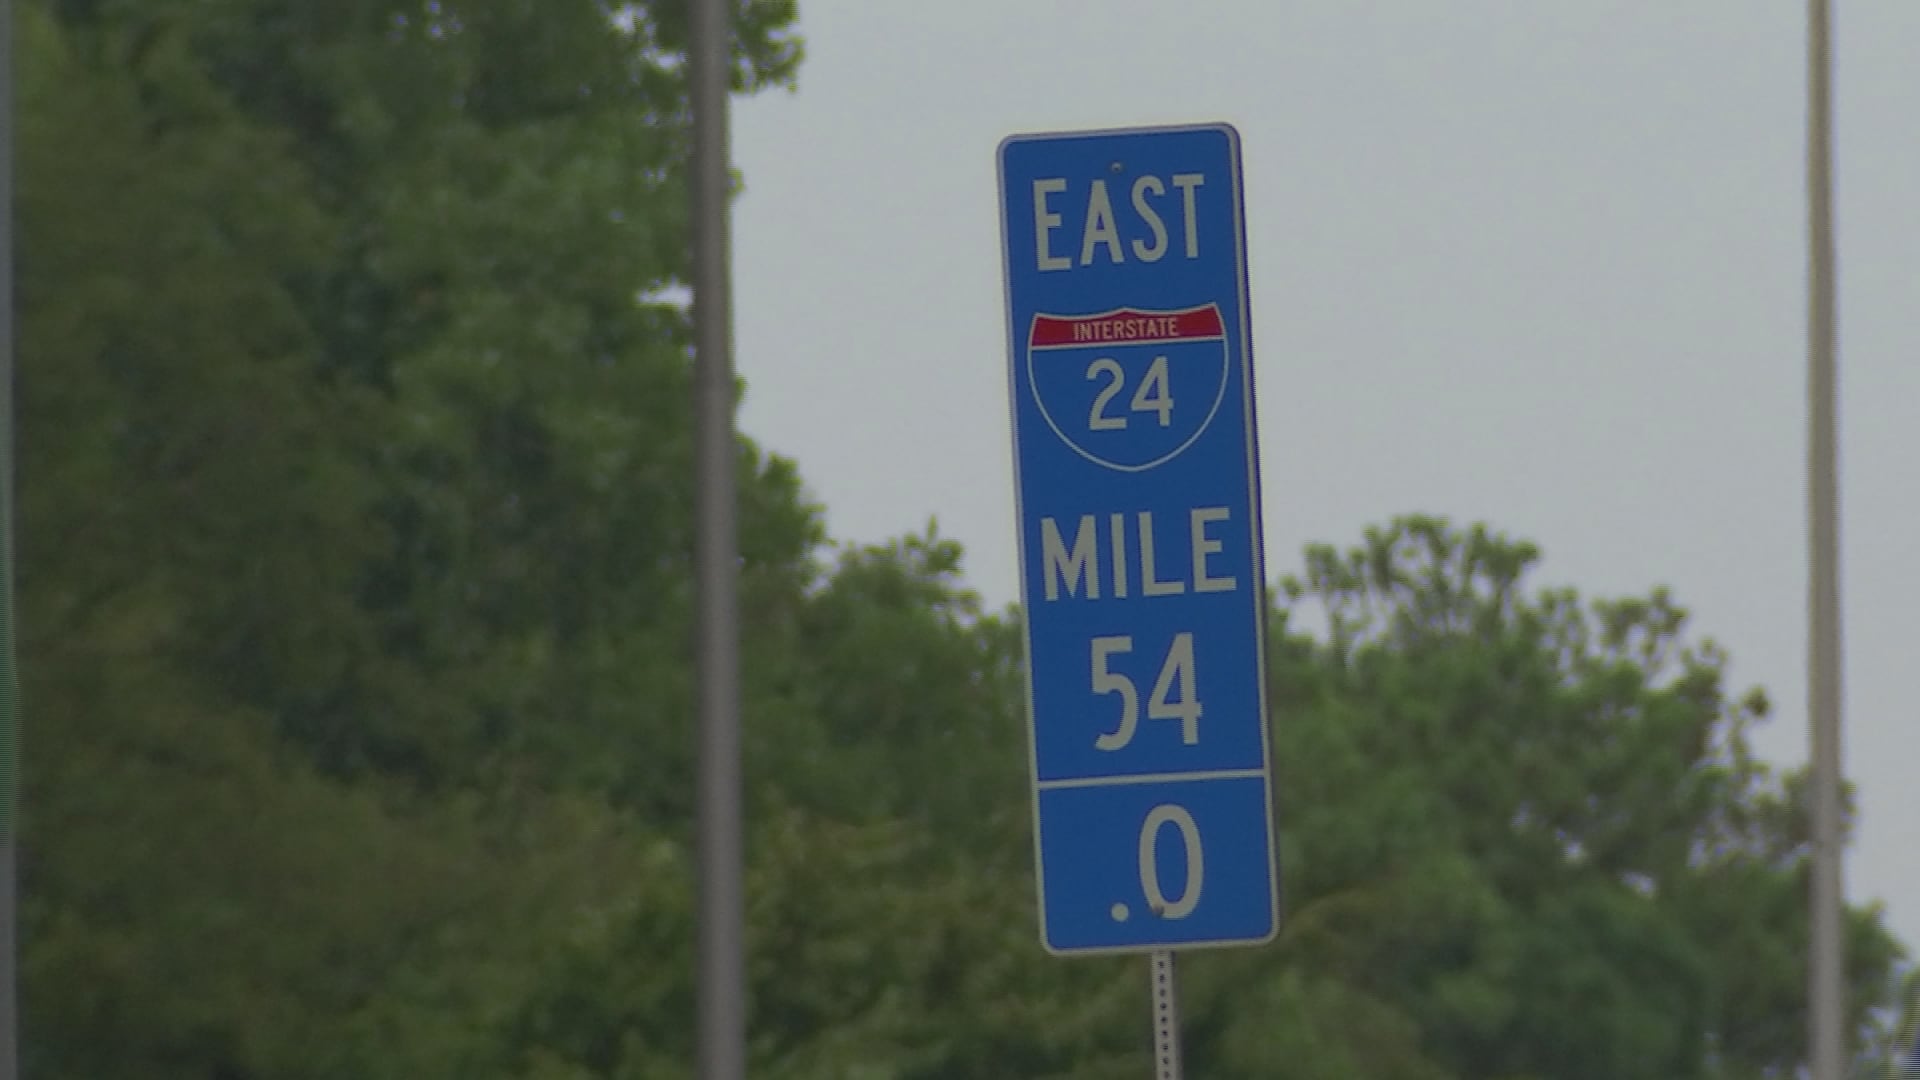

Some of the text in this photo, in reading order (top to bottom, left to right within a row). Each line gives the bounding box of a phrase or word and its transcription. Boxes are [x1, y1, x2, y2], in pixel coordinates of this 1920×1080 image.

[1032, 174, 1204, 271] EAST
[1073, 317, 1180, 341] INTERSTATE
[1086, 356, 1174, 430] 24
[1041, 507, 1237, 601] MILE
[1091, 632, 1202, 751] 54
[1111, 804, 1204, 922] .0
